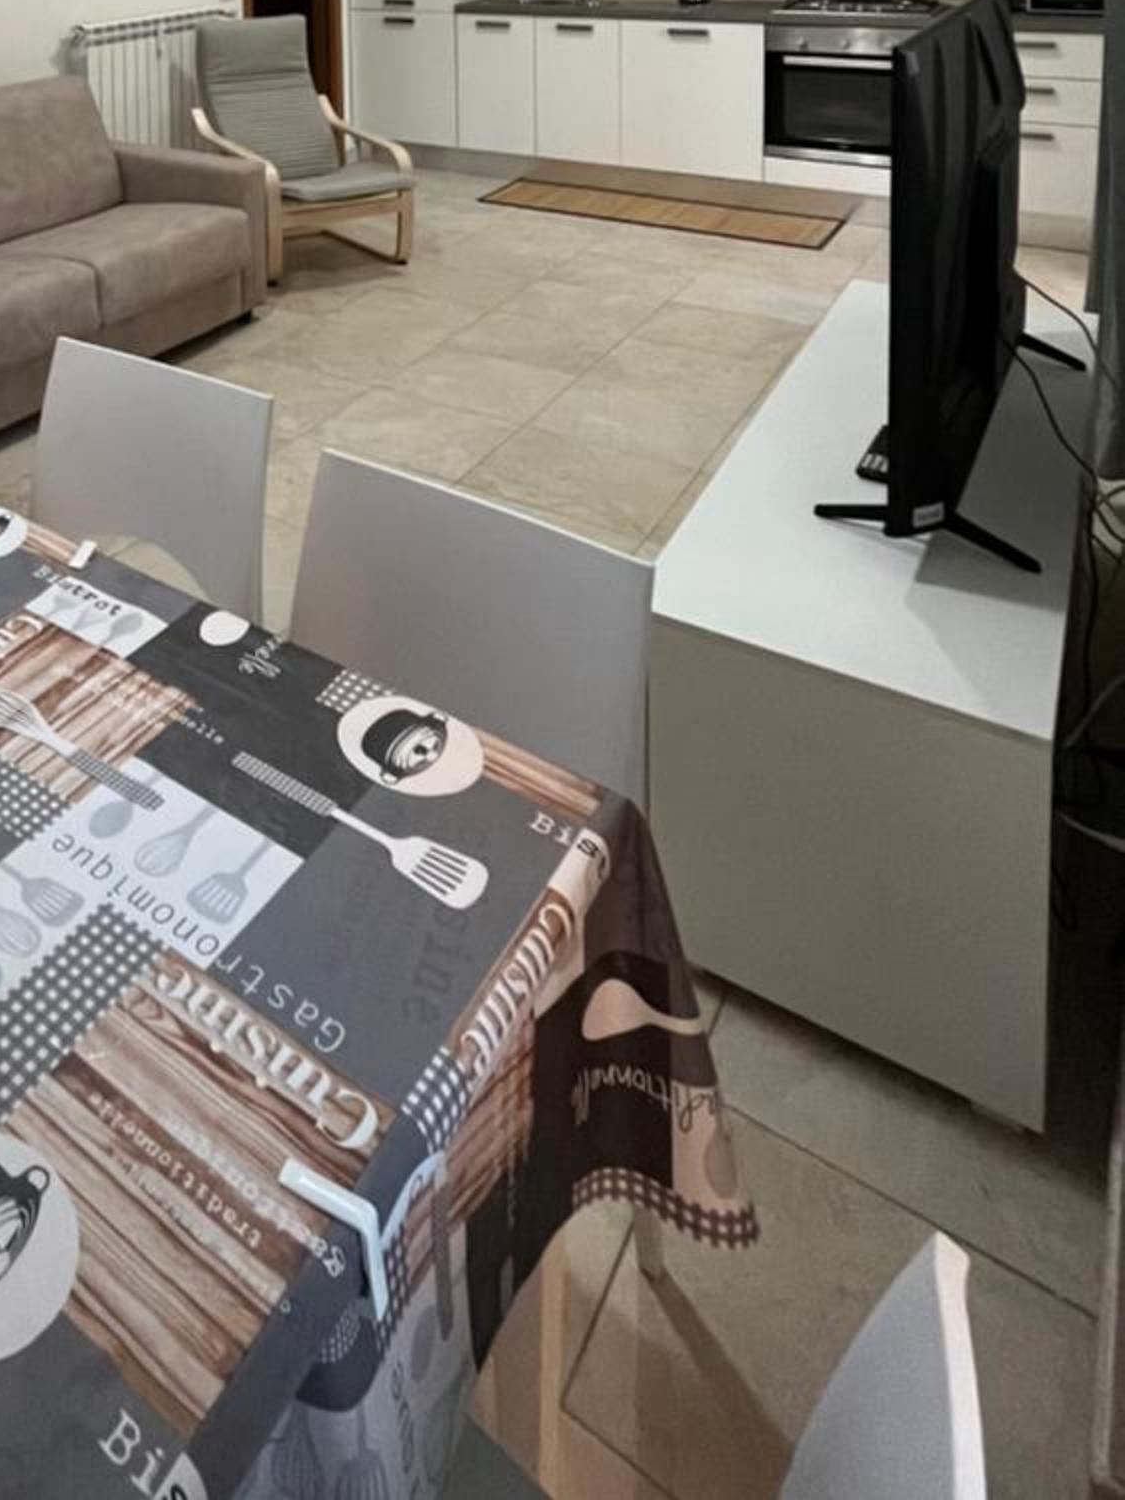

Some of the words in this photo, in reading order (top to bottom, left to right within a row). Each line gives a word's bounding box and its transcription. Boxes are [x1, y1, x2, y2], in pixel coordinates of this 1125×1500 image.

[50, 832, 347, 1054] Gastronomique
[155, 967, 379, 1150] Cuisine
[87, 1090, 262, 1249] traditionnelle
